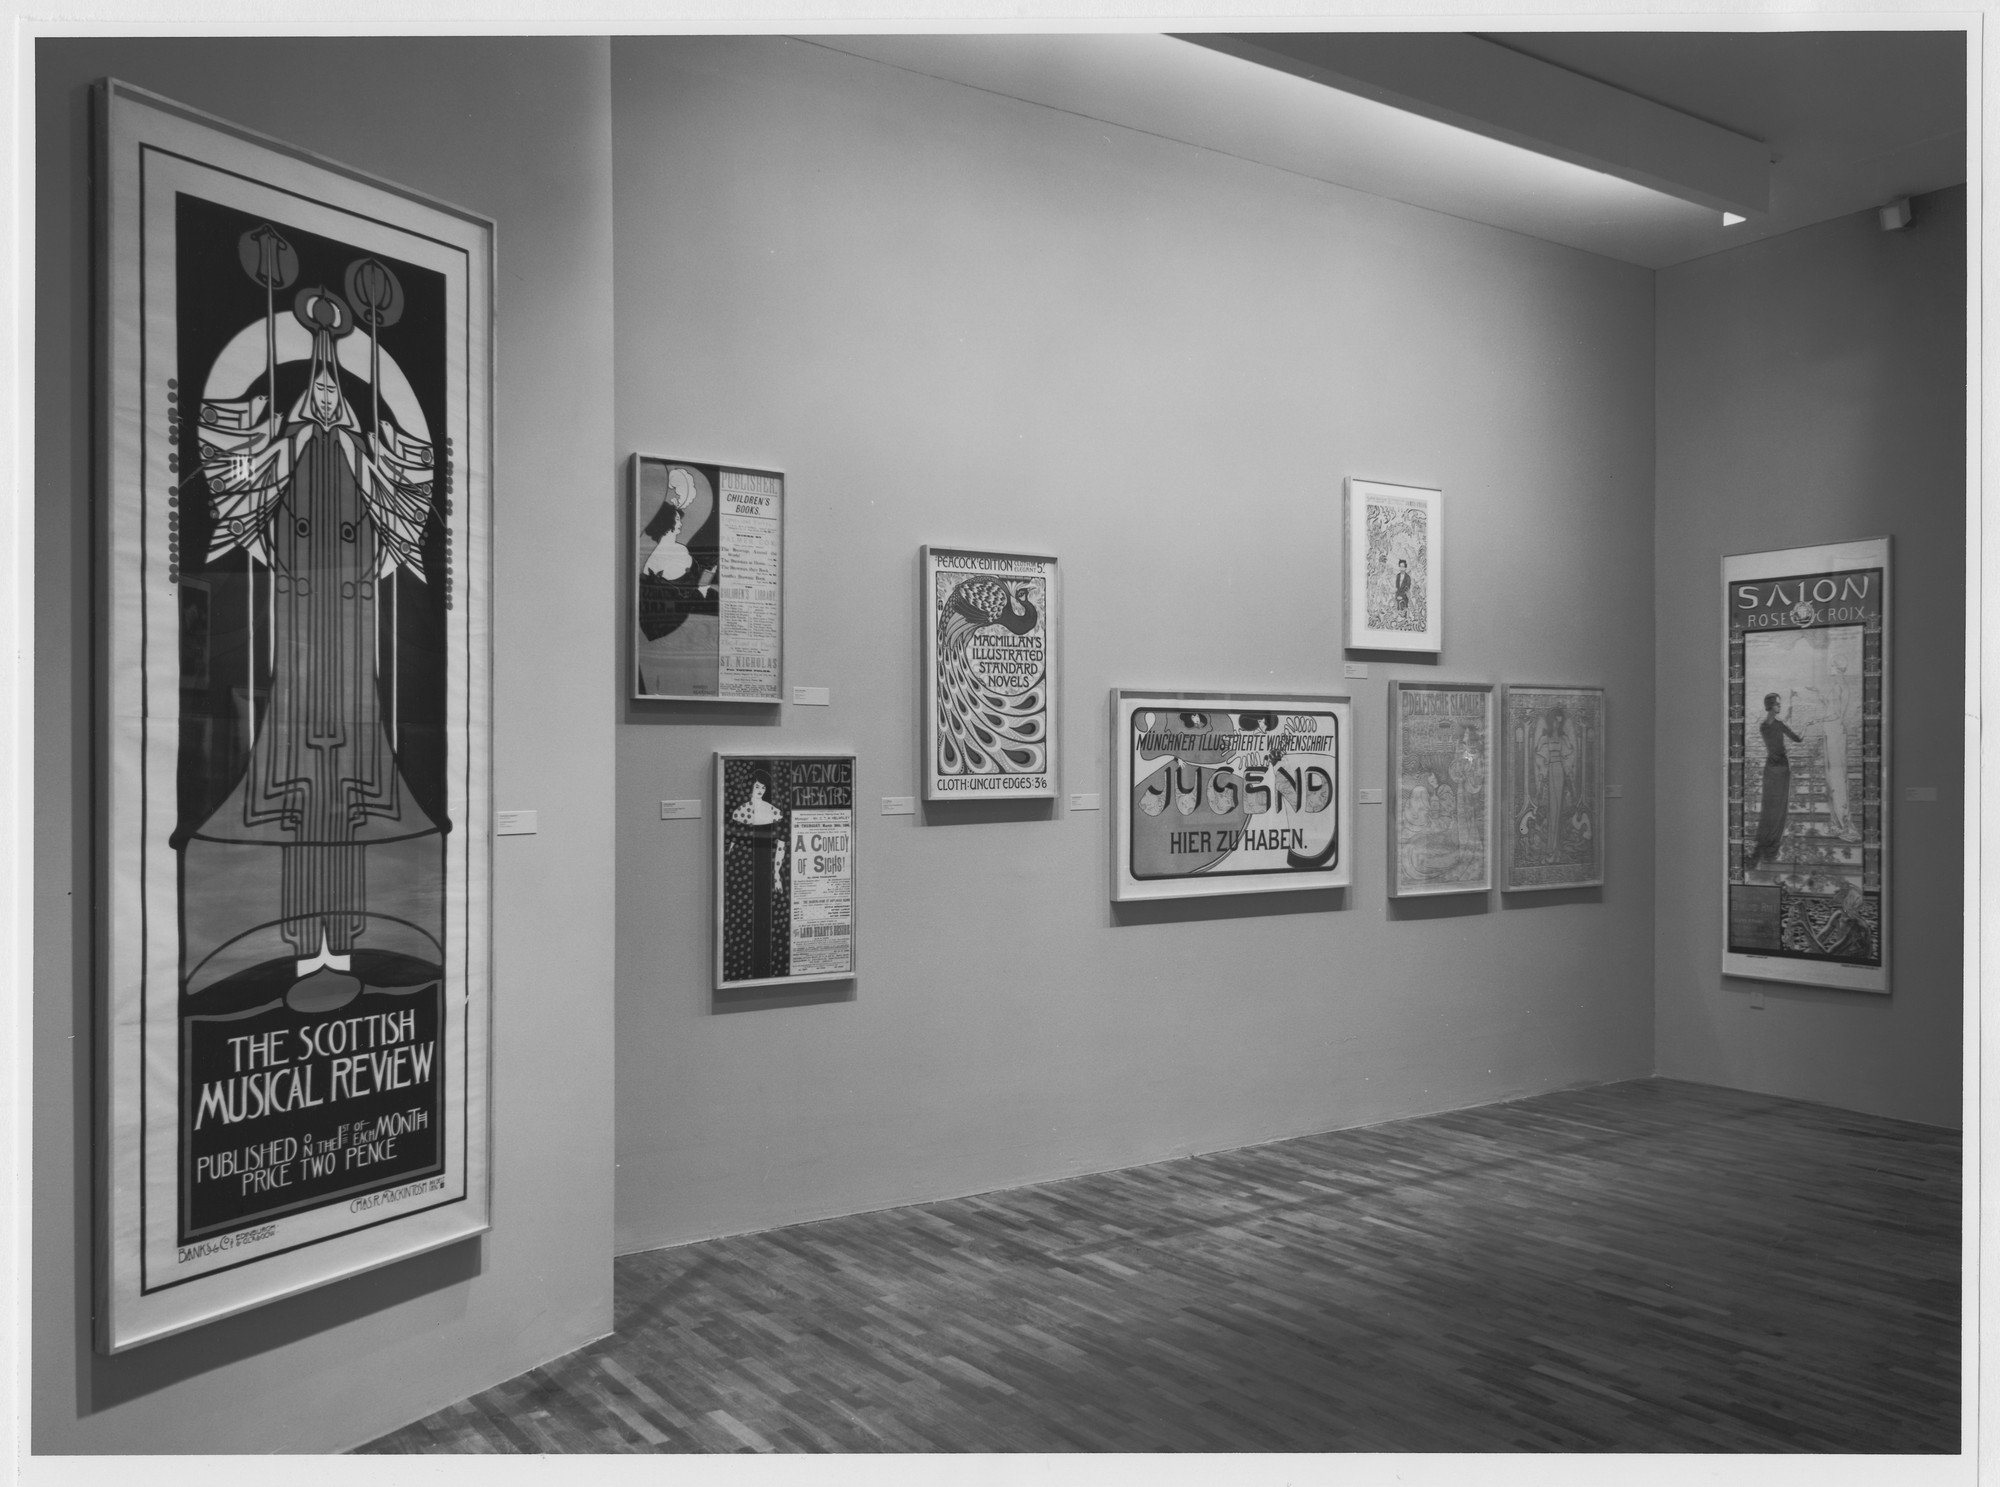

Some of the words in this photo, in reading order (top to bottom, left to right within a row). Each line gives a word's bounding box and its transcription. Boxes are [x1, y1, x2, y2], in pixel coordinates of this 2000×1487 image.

[726, 493, 770, 506] CHILDREN'S
[735, 504, 760, 515] BOOKS.
[937, 556, 977, 570] PEACOCK
[979, 558, 1013, 571] EDITION
[1738, 575, 1869, 609] SALON
[1748, 612, 1786, 628] ROSE
[1816, 606, 1865, 623] CROIX
[973, 634, 1042, 648] MACMILLAN'S
[736, 656, 777, 669] NICHOLAS
[972, 648, 1043, 662] ILLUSTRATED
[979, 662, 1037, 677] STANDARD
[988, 676, 1029, 687] NOVELS
[1136, 731, 1196, 751] MÜNCHNER
[1199, 734, 1266, 751] ILLUSTRIERTE
[791, 764, 850, 784] AVENUE
[970, 778, 1001, 790] UNCUT
[792, 786, 850, 806] THEATRE
[1138, 766, 1333, 817] JUGEND
[794, 834, 806, 852] A
[811, 834, 849, 854] COMEDY
[1170, 831, 1212, 854] HIER
[1216, 830, 1239, 852] ZU
[1244, 828, 1307, 851] HABEN.
[797, 858, 807, 876] OF
[227, 1029, 289, 1073] THE
[297, 1008, 416, 1060] SCOTTISH
[194, 1064, 324, 1131] MUSICAL
[330, 1041, 435, 1102] REVIEW
[354, 1120, 371, 1132] OF
[375, 1107, 428, 1141] MONTH
[317, 1137, 340, 1153] THE
[353, 1129, 376, 1146] EACH
[197, 1137, 298, 1183] PUBLISHED
[242, 1162, 293, 1196] PRICE
[300, 1152, 336, 1180] TWO
[345, 1137, 398, 1170] PENCE
[178, 1243, 212, 1264] BANKS
